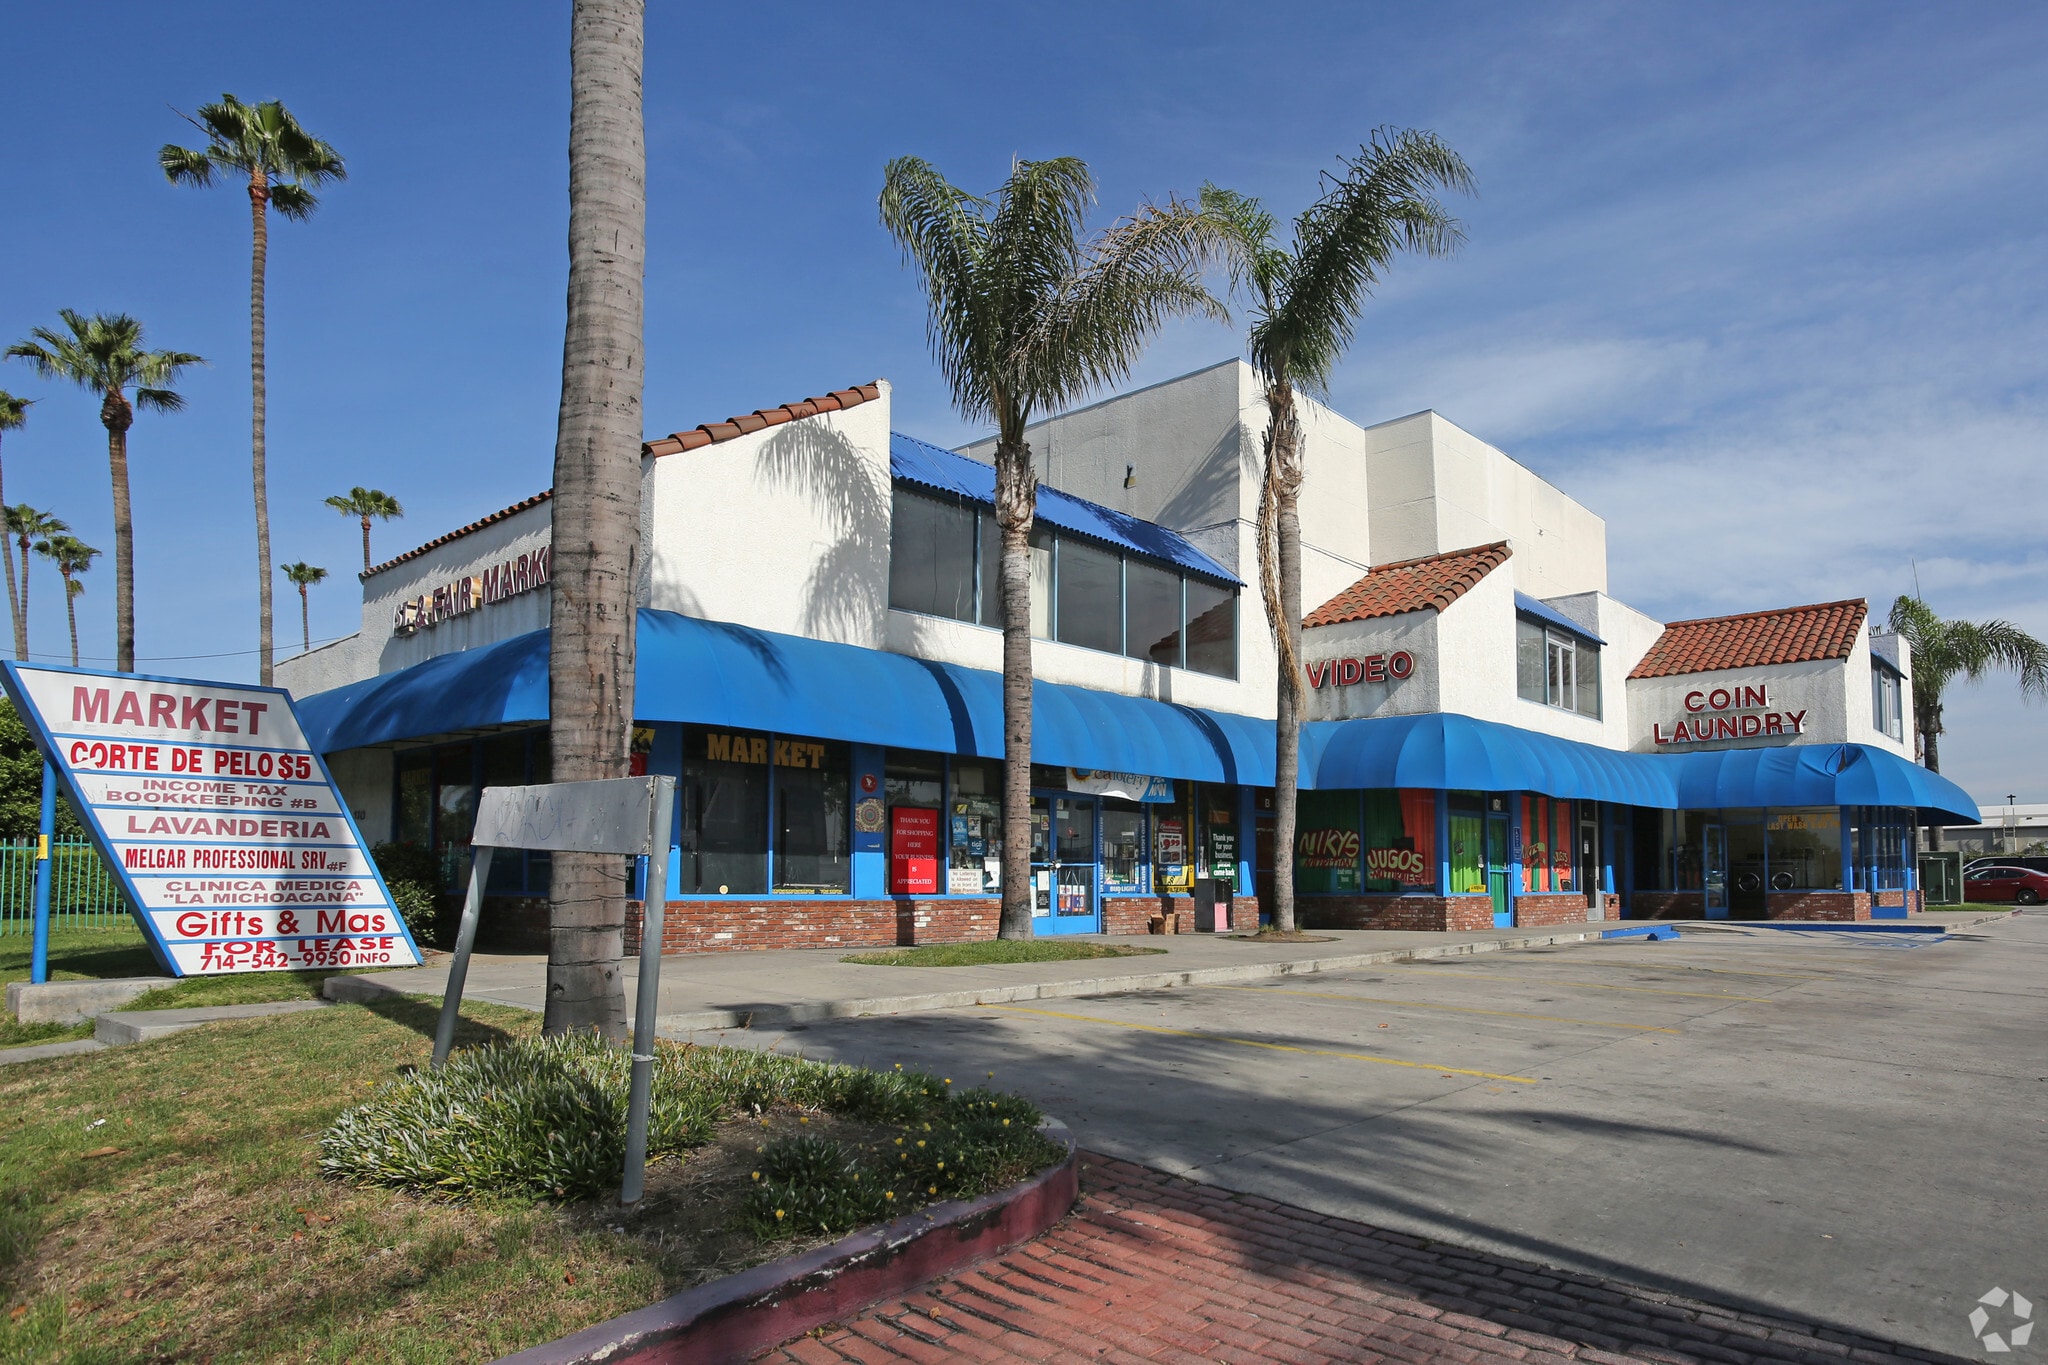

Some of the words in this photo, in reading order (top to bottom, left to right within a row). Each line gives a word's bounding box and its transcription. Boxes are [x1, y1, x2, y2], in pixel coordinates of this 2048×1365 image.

[415, 595, 429, 628] &
[432, 576, 473, 622] FAIR
[1305, 651, 1413, 688] VIDEO
[1684, 684, 1769, 712] COIN
[72, 686, 267, 735] MARKET
[1653, 710, 1807, 744] LAUNDRY
[70, 741, 159, 770] CORTE
[171, 748, 202, 772] DE
[214, 750, 273, 777] PELO
[278, 752, 311, 780] $5
[707, 733, 825, 768] MARKET
[143, 779, 236, 793] INCOME
[243, 784, 288, 796] TAX
[106, 790, 283, 808] BOOKKEEPING
[290, 798, 318, 808] #B
[128, 815, 331, 838] LAVANDERIA
[1767, 822, 1784, 830] LAST
[1787, 821, 1808, 830] WASH
[1777, 814, 1798, 822] OPEN
[1212, 833, 1226, 841] Thank
[1226, 834, 1234, 843] you
[1223, 843, 1232, 853] your
[1299, 829, 1360, 857] NIKYS
[125, 848, 186, 868] MELGAR
[193, 849, 296, 869] PROFESSIONAL
[1214, 851, 1233, 860] business,
[1367, 849, 1424, 873] JUGOS
[1225, 868, 1235, 876] back
[165, 881, 267, 892] CLINICA
[275, 881, 361, 891] MEDICA
[163, 893, 208, 904] "LA
[213, 892, 364, 903] MICHOACANA"
[176, 911, 263, 937] Gifts
[276, 910, 299, 934] &
[317, 909, 386, 934] Mas
[204, 940, 277, 955] FOR
[298, 937, 394, 952] LEASE
[200, 950, 351, 970] 714-542-9950
[355, 953, 390, 964] INFO
